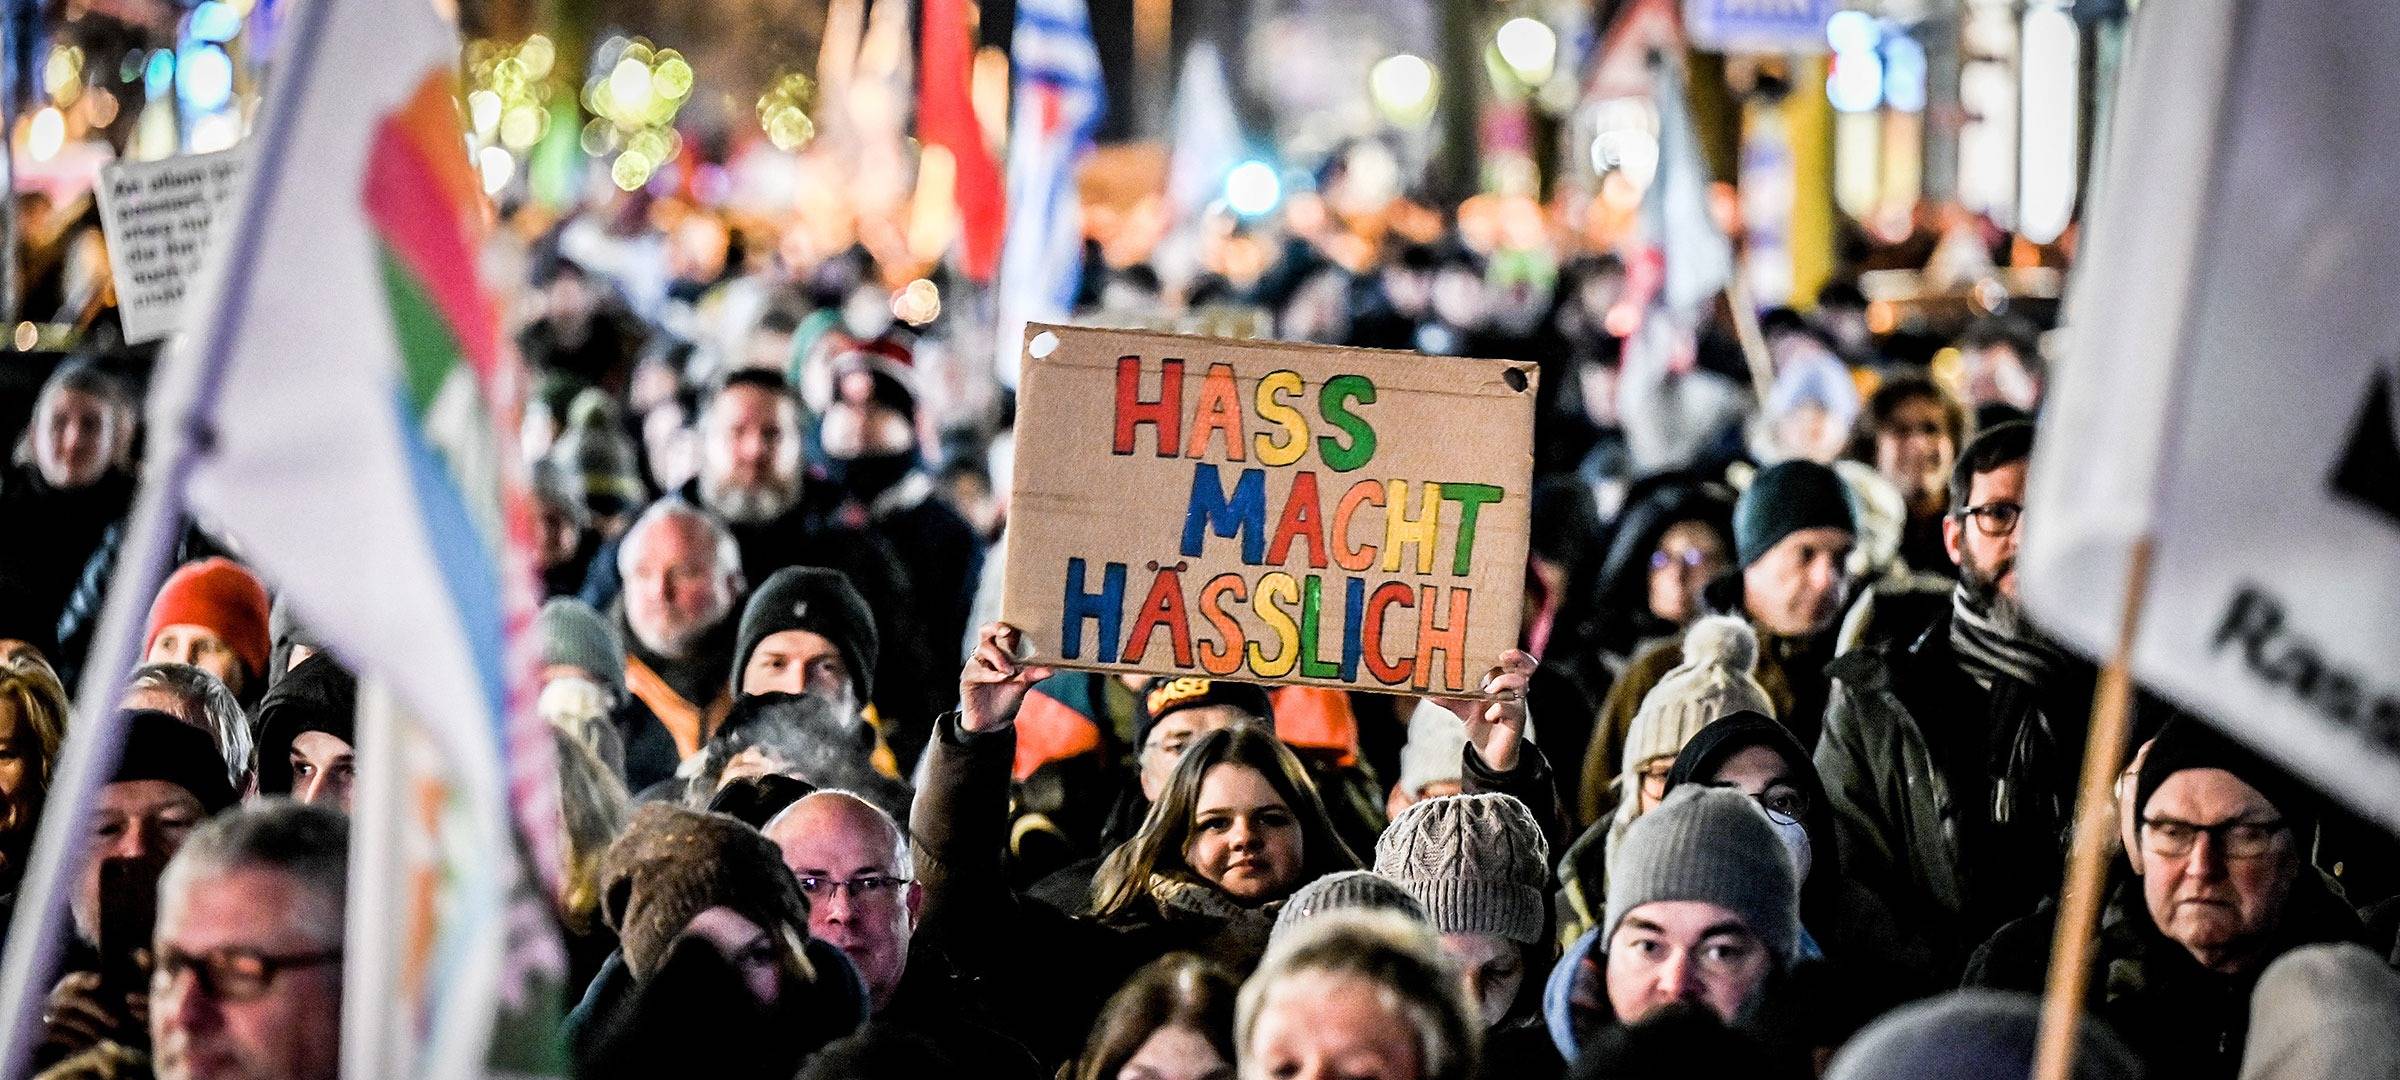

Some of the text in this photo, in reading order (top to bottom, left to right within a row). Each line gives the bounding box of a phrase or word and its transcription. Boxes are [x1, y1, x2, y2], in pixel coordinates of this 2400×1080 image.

[1113, 356, 1377, 472] HASS
[1180, 463, 1504, 577] MACHT
[1062, 557, 1470, 691] HÄSSLICH
